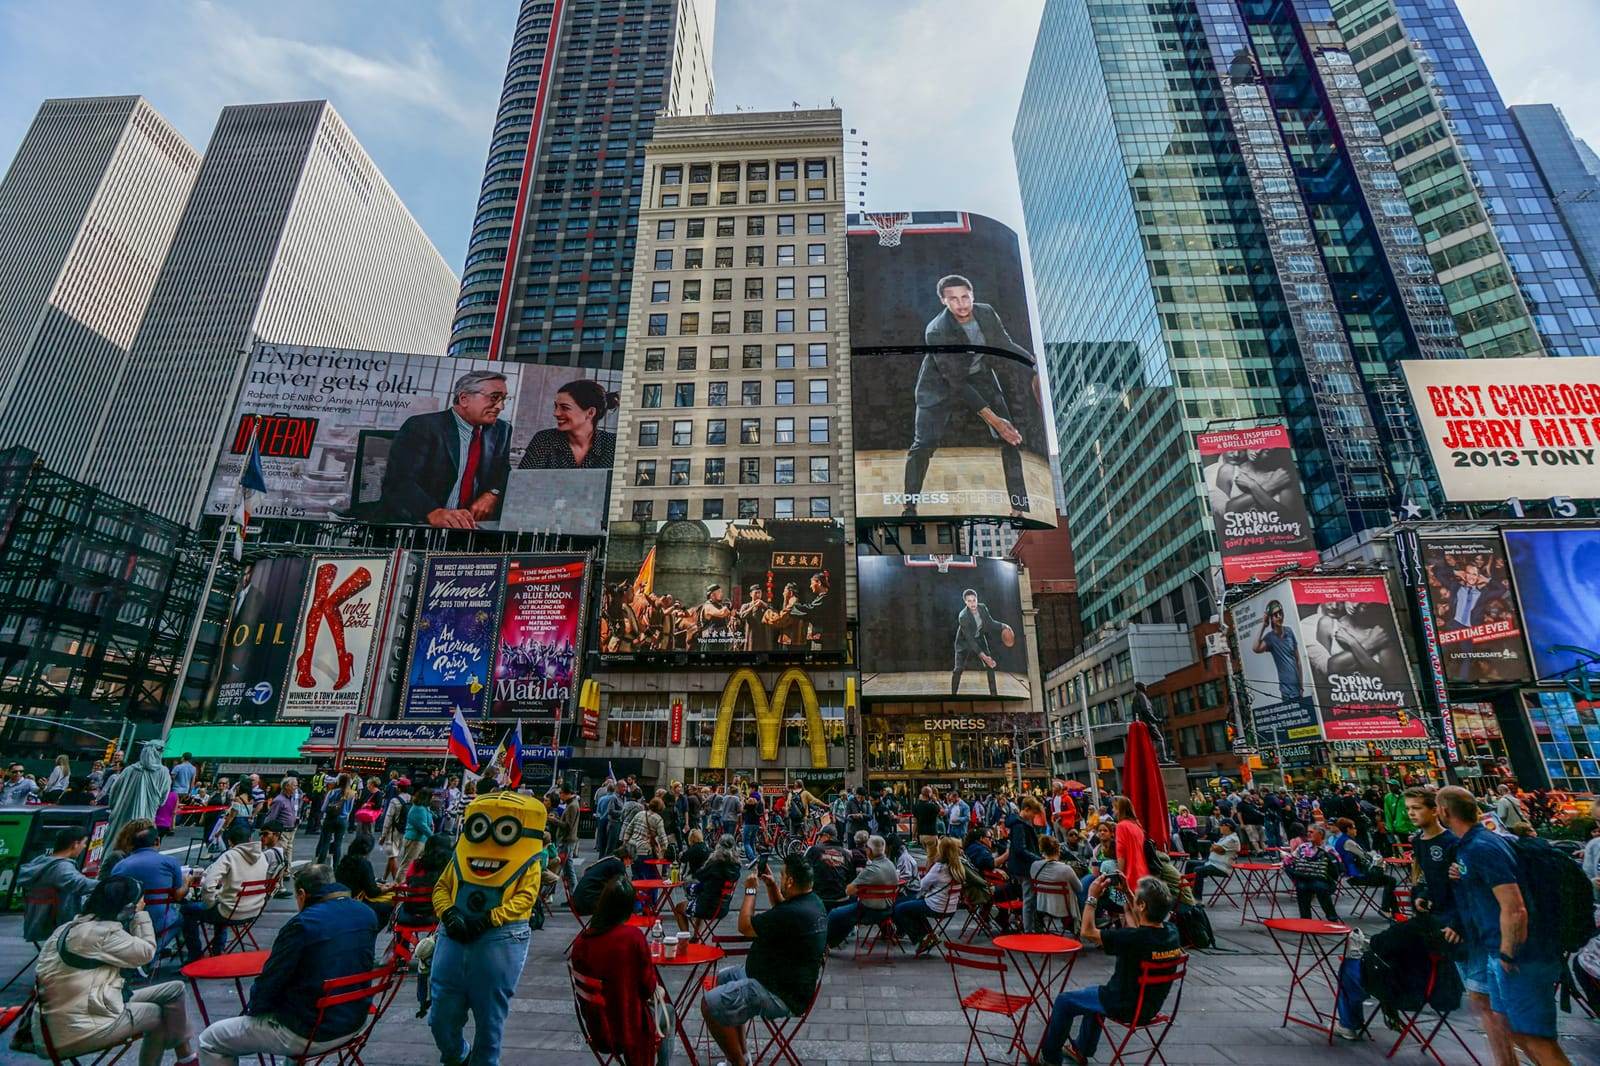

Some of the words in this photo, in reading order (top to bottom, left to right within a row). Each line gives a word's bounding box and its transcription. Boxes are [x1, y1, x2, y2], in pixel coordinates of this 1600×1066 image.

[256, 345, 387, 372] Experience
[250, 371, 316, 387] never
[319, 375, 369, 394] gets
[375, 375, 418, 395] old.
[247, 390, 278, 399] Robert
[297, 393, 323, 403] NIRO
[328, 396, 353, 405] Anne
[355, 399, 411, 409] HATHAWAY
[1427, 385, 1486, 417] BEST
[234, 416, 316, 457] INTERN
[1242, 429, 1281, 439] INSPIRED
[1442, 419, 1525, 449] JERRY
[1452, 450, 1521, 467] 2013
[1522, 449, 1595, 466] TONY
[883, 493, 949, 505] EXPRESS
[291, 507, 306, 517] 25
[1223, 511, 1281, 529] SPRING
[1225, 521, 1301, 537] awakening
[429, 578, 496, 599] Winner!
[544, 592, 573, 600] MOON,
[440, 600, 453, 608] 2015
[454, 600, 468, 608] TONY
[469, 600, 492, 608] AWARDS
[389, 563, 417, 682] PALACE
[1439, 630, 1461, 644] BEST
[1461, 625, 1485, 639] TIME
[1485, 620, 1510, 634] EVER
[232, 622, 285, 647] OIL
[438, 623, 455, 643] An
[426, 636, 481, 662] American
[1468, 651, 1502, 659] TUESDAYS
[433, 654, 469, 673] Paris
[219, 687, 244, 697] SUNDAY
[492, 676, 570, 702] Matilda
[1328, 673, 1383, 692] SPRING
[217, 697, 233, 706] SEPT
[233, 697, 243, 705] 27
[289, 692, 313, 700] WINNER!
[319, 692, 334, 700] TONY
[335, 692, 359, 701] AWARDS
[1330, 685, 1405, 707] awakening
[364, 726, 376, 737] An
[376, 724, 414, 738] American
[416, 725, 436, 738] Paris
[924, 719, 986, 730] EXPRESS
[1333, 740, 1367, 751] GIFTS
[1374, 739, 1428, 750] LUGGAGE
